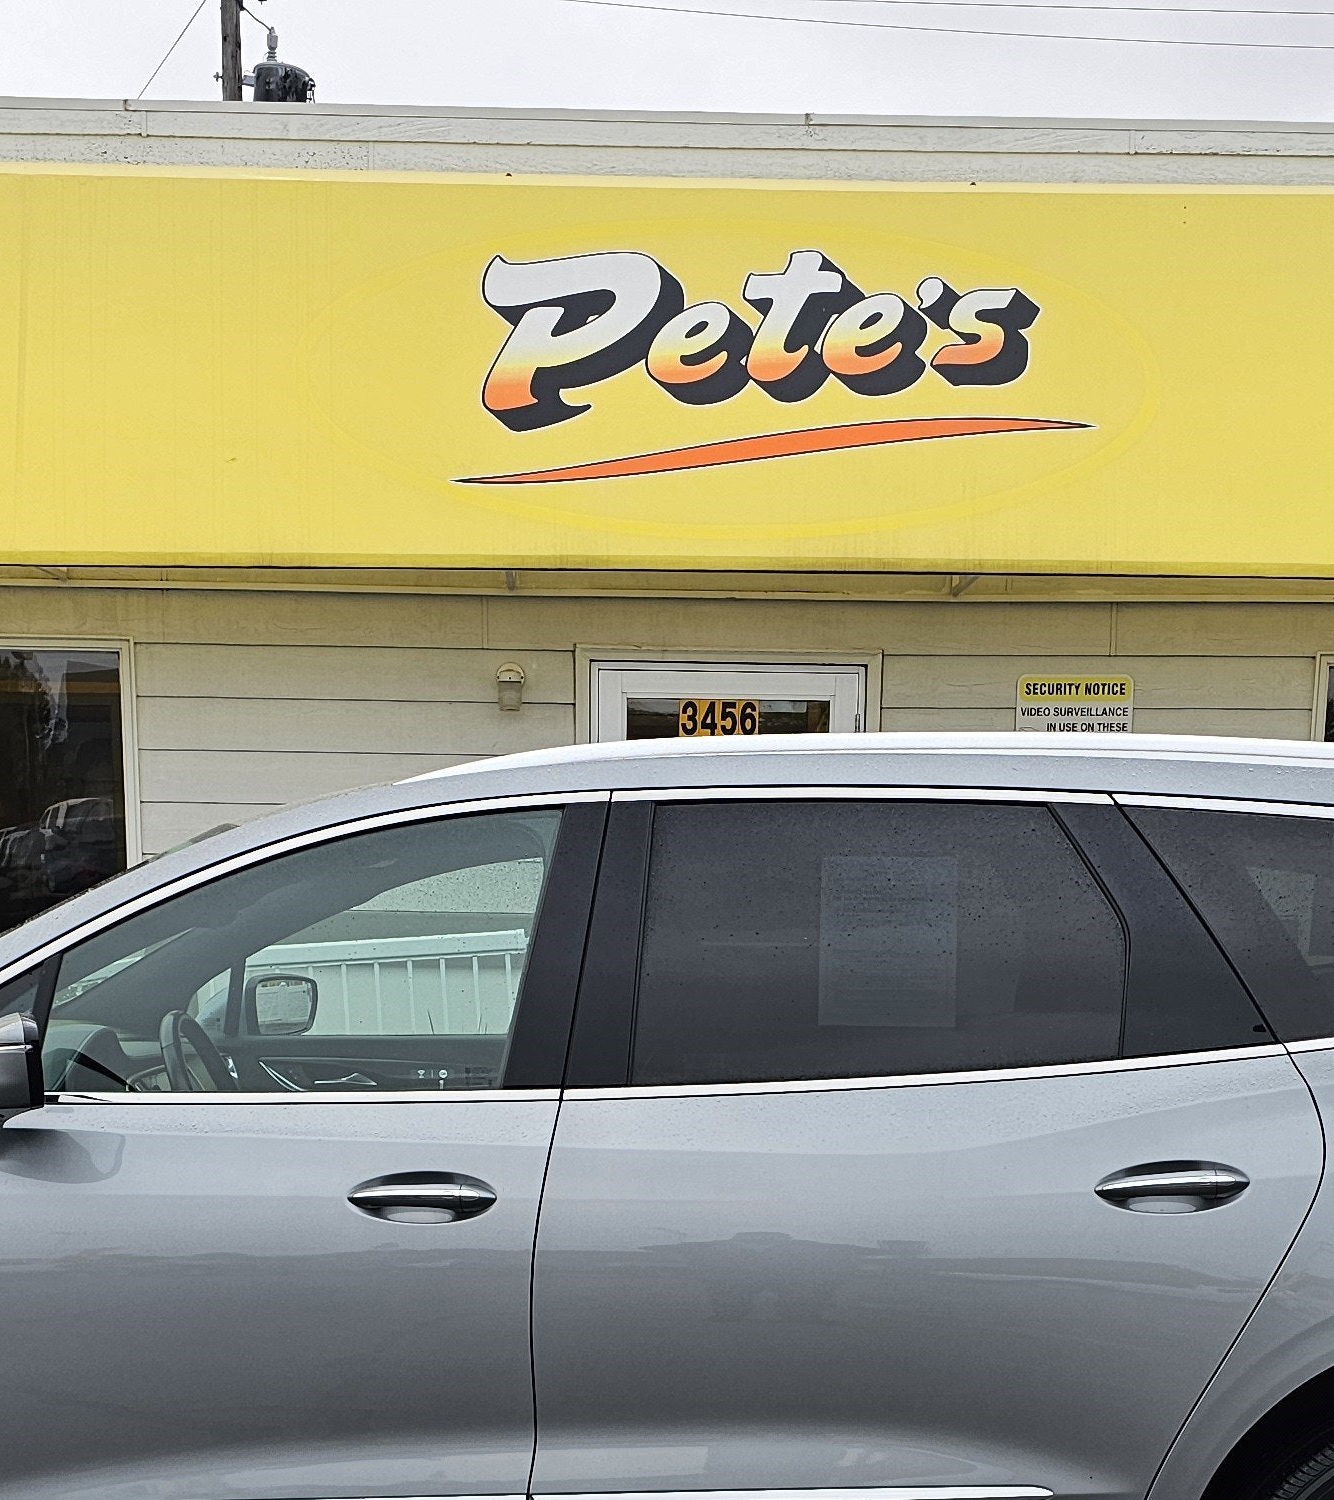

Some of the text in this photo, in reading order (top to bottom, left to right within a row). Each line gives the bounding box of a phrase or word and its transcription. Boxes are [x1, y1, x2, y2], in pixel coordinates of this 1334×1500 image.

[481, 250, 1040, 432] Pete's
[1025, 682, 1126, 695] SECURITY NOTICE
[1020, 706, 1129, 717] VIDEO SURVEILLANCE
[681, 701, 757, 736] 3456
[1046, 722, 1128, 732] IN USE ON THESE
